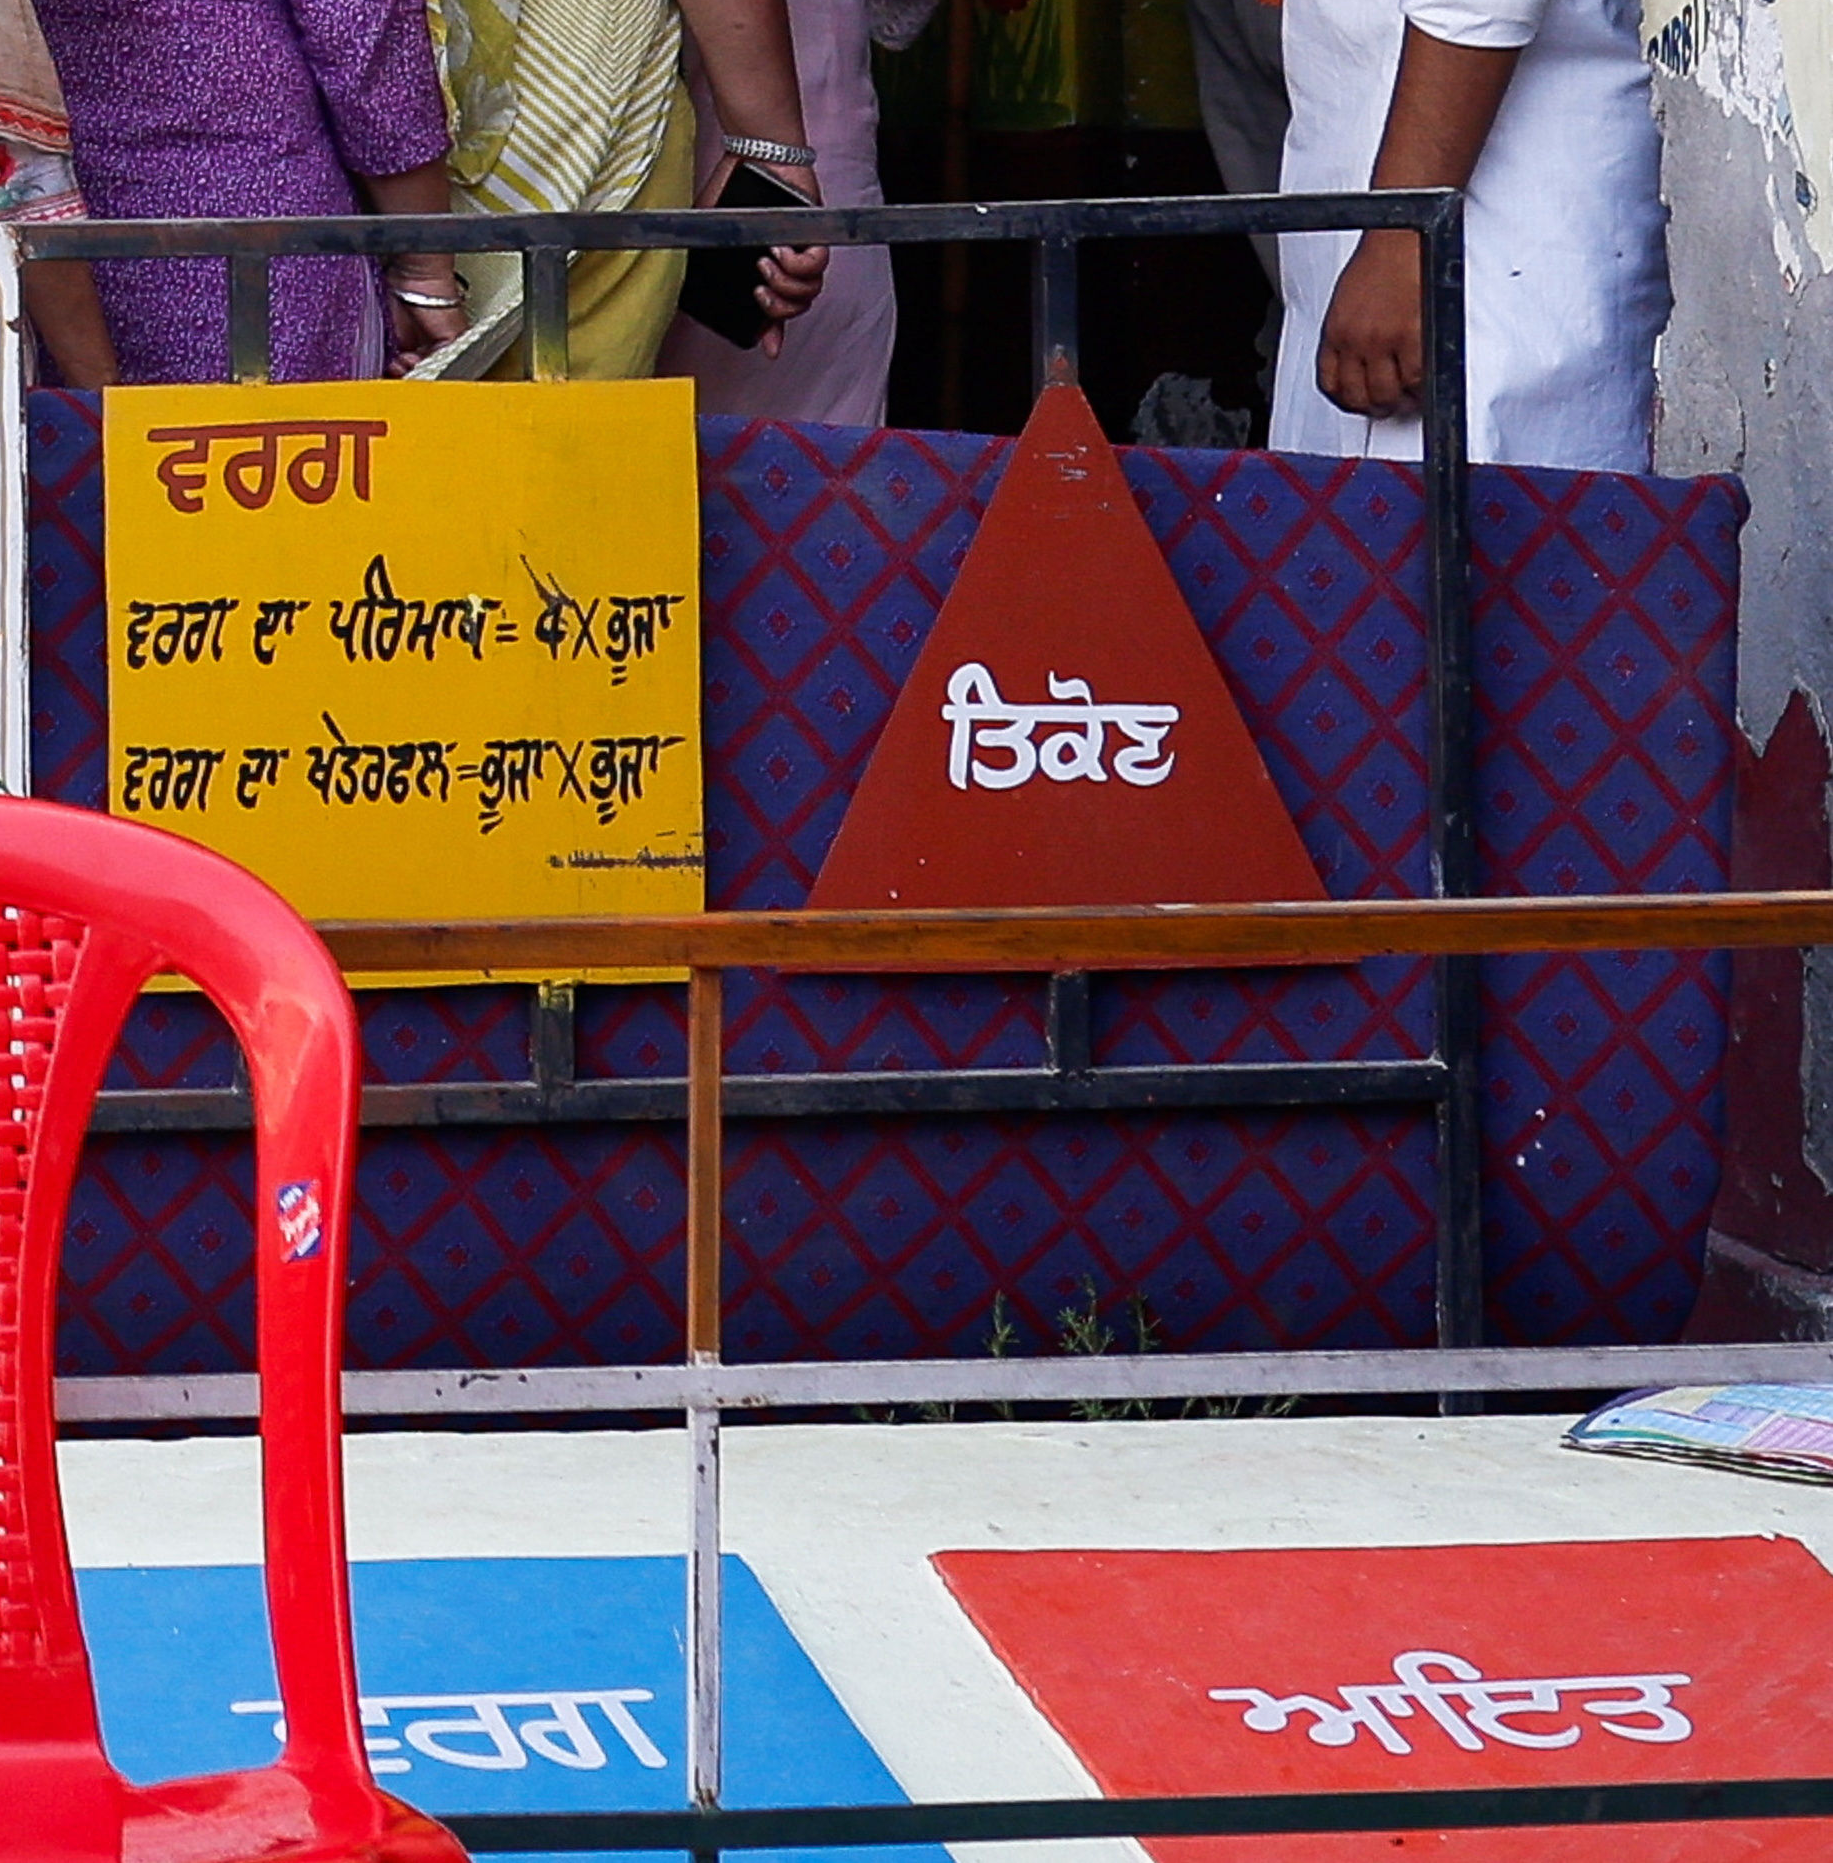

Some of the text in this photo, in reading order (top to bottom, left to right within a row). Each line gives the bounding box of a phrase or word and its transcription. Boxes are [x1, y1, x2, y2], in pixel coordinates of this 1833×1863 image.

[147, 419, 388, 514] ਵਰਗ
[125, 596, 239, 670] ਵਰਗ
[253, 598, 311, 665] ਦਾ
[941, 663, 1180, 790] ਤਿਕੋਣ
[122, 741, 227, 813] ਵਰਗ
[236, 743, 290, 809] ਦਾ
[1207, 1649, 1694, 1754] ਆਇਤ
